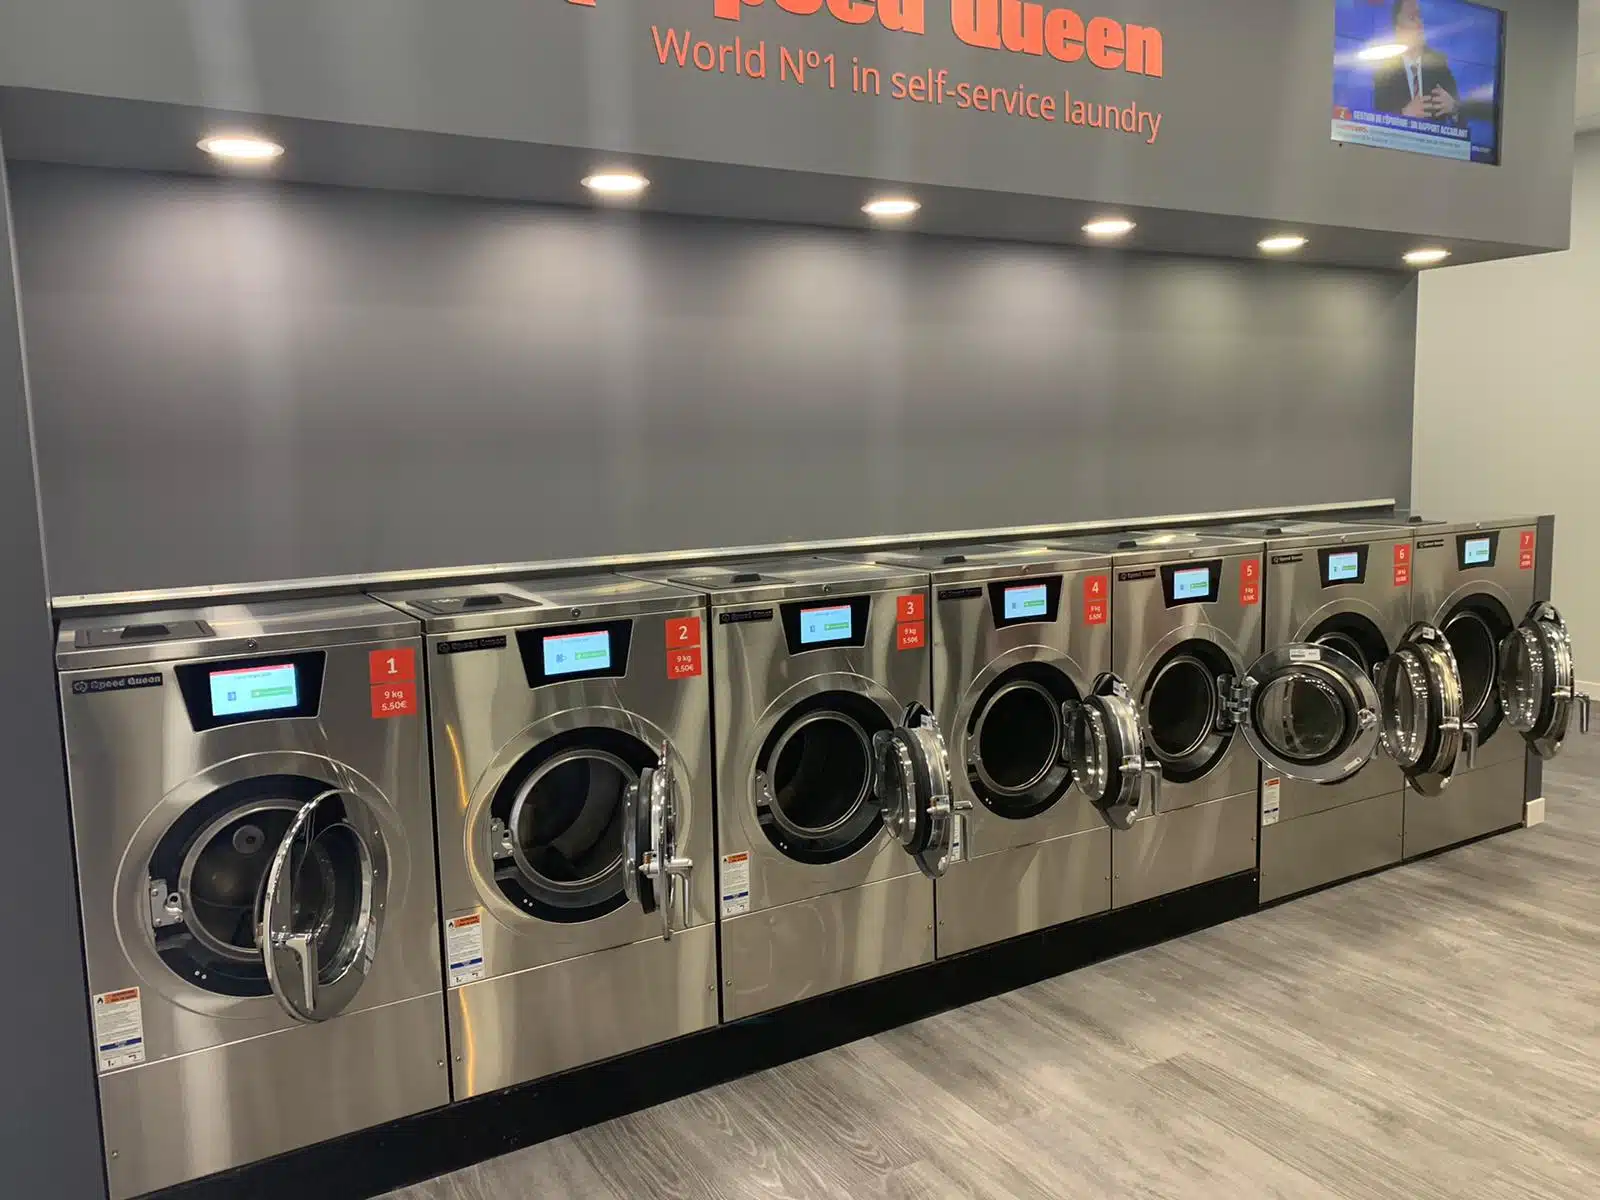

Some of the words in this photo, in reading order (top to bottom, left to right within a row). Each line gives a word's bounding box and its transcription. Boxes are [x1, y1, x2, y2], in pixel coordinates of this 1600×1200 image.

[951, 0, 1163, 78] Queen
[651, 25, 766, 79] World
[853, 57, 881, 96] in
[890, 68, 1056, 121] self-service
[1063, 90, 1162, 144] laundry
[1400, 548, 1405, 560] 6
[1091, 581, 1099, 593] 4
[906, 601, 915, 615] 3
[678, 625, 688, 640] 2
[386, 656, 398, 675] 1
[676, 655, 682, 663] 9
[682, 655, 692, 664] kg
[127, 676, 161, 686] Queen
[383, 690, 390, 700] 9
[391, 690, 404, 700] kg
[381, 700, 408, 712] 5.50€
